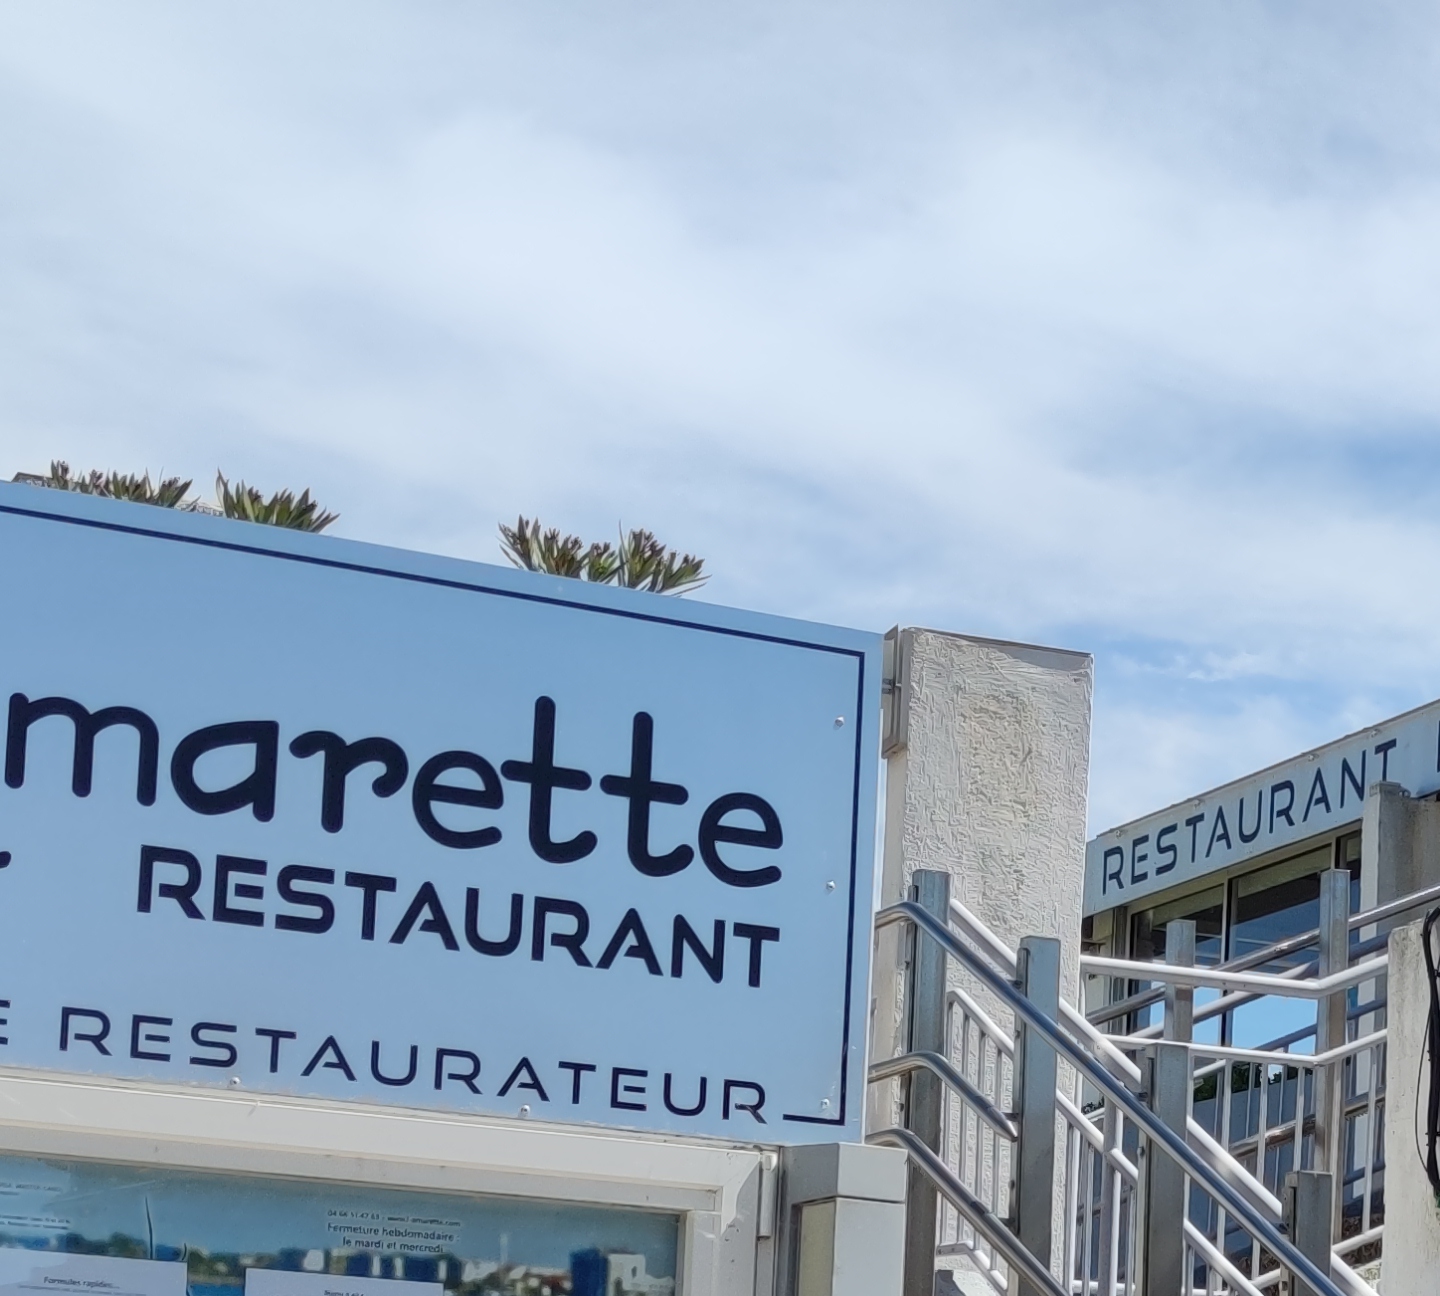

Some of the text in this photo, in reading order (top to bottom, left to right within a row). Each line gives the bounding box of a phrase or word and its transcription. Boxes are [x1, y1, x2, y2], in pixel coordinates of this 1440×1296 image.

[1103, 738, 1397, 895] RESTAURANT
[137, 844, 780, 988] RESTAURANT
[59, 1006, 768, 1124] RESTAURATEUR
[327, 1222, 455, 1242] Fermeture hebdomadaire
[342, 1236, 352, 1247] le
[354, 1238, 384, 1249] mardi
[399, 1241, 444, 1254] mercredi
